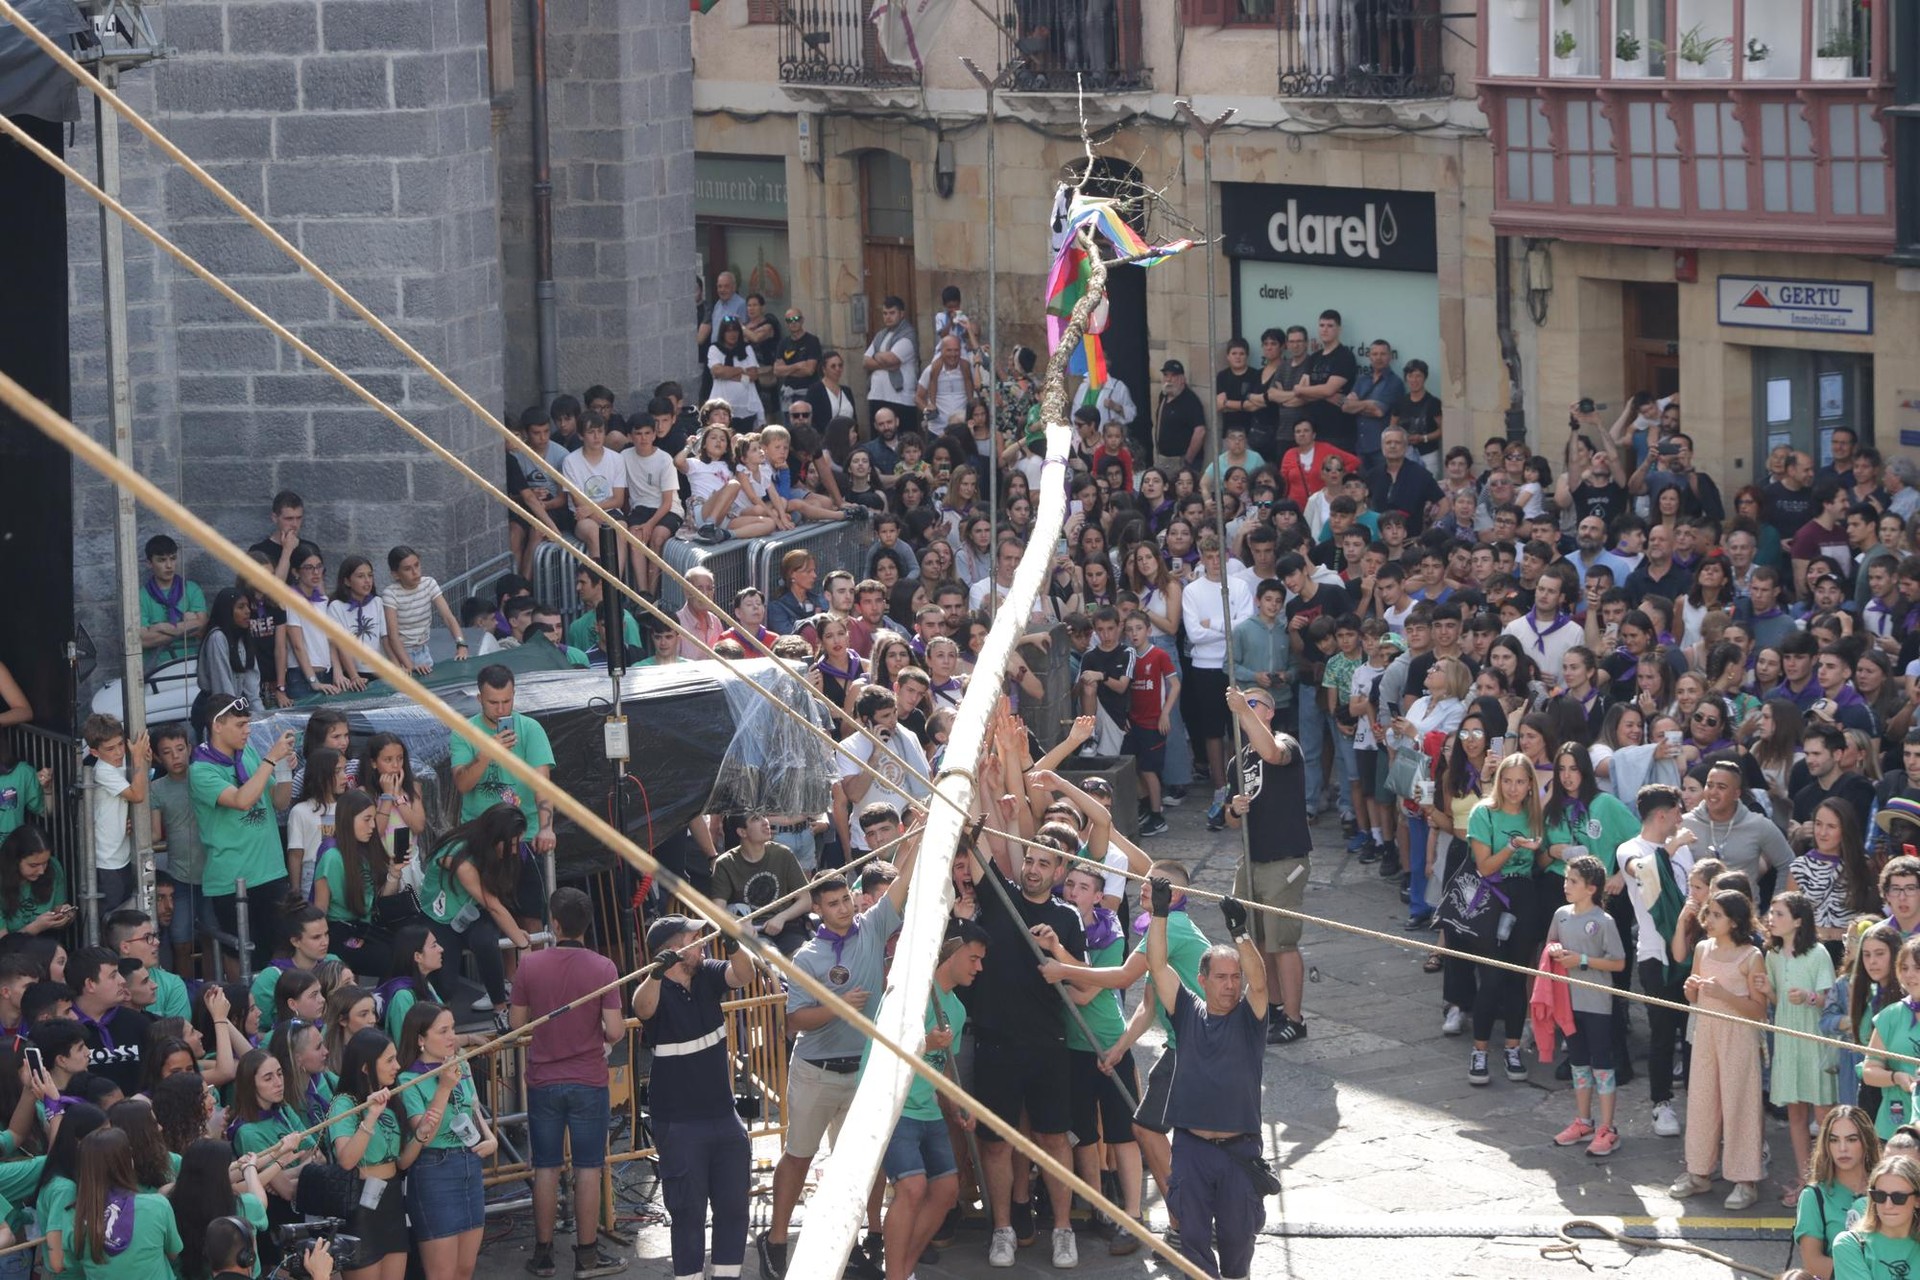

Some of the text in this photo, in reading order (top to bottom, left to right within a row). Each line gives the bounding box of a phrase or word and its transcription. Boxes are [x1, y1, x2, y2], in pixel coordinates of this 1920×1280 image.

[1267, 199, 1380, 259] clarel
[1259, 284, 1289, 300] clarel
[1779, 286, 1841, 306] GERTU
[1790, 312, 1847, 327] Inmobiliaria
[87, 1044, 140, 1065] OSS
